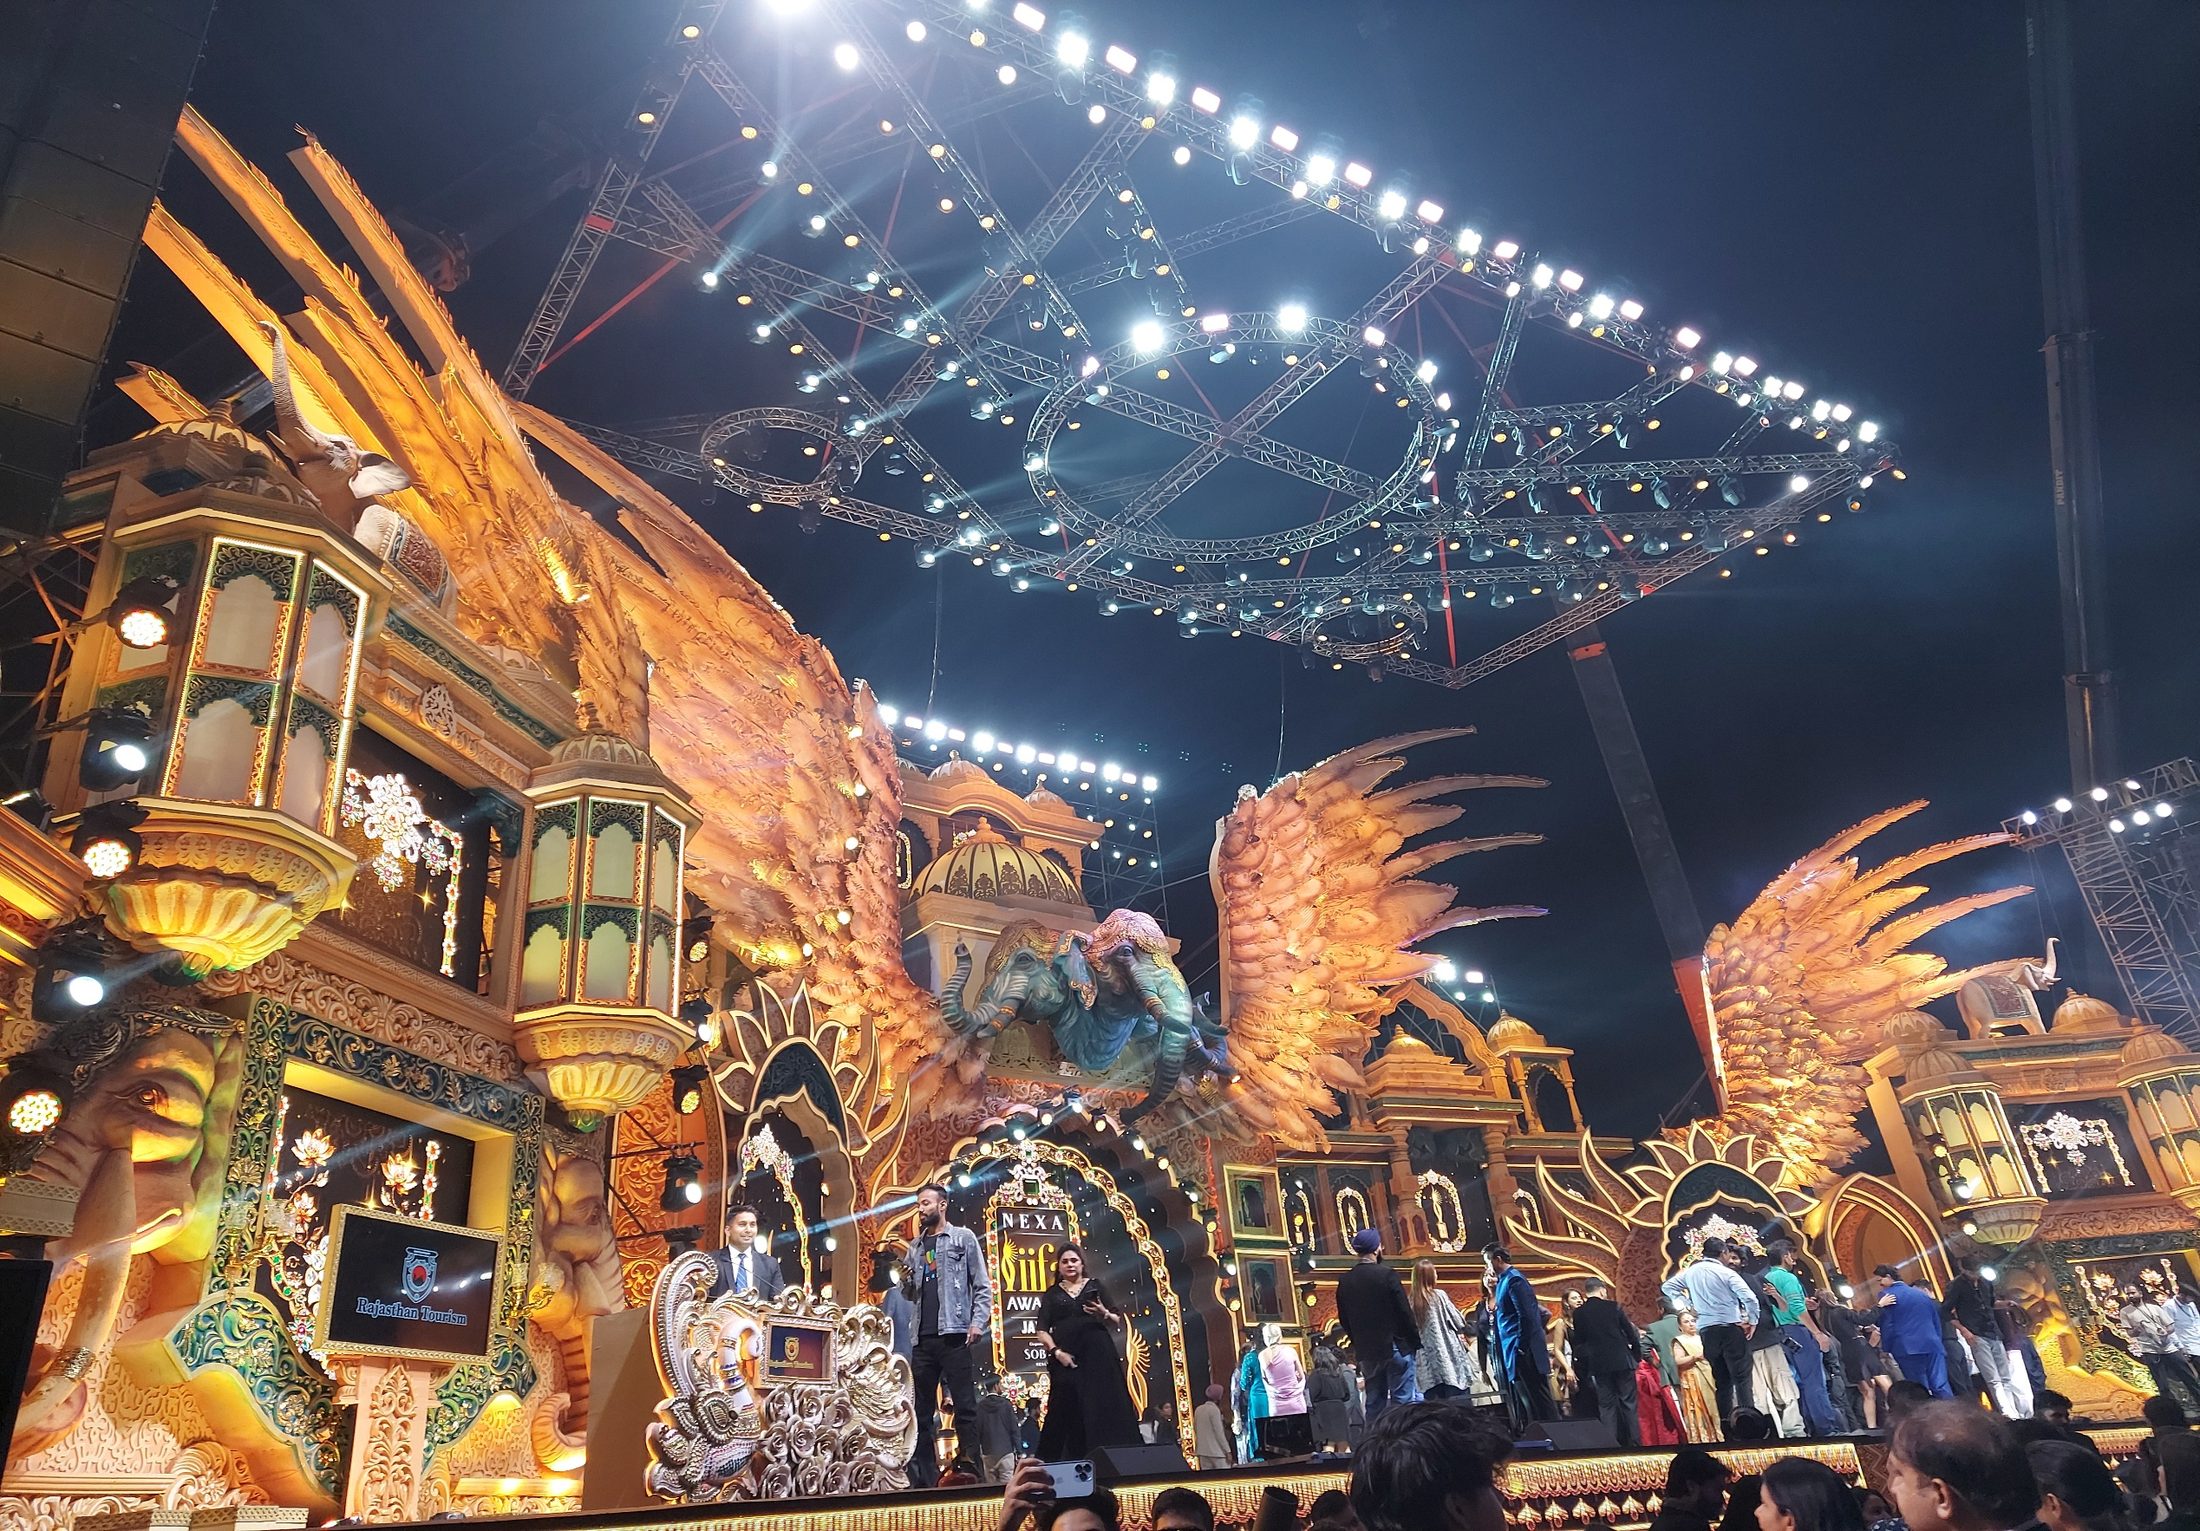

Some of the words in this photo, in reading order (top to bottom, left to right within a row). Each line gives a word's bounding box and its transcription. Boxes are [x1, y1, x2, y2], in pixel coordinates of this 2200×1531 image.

[1002, 1212, 1064, 1231] NEXA
[356, 1297, 419, 1320] Rajasthan
[421, 1305, 467, 1326] Tourism
[1006, 1296, 1042, 1311] AWA
[1023, 1348, 1050, 1360] SOB
